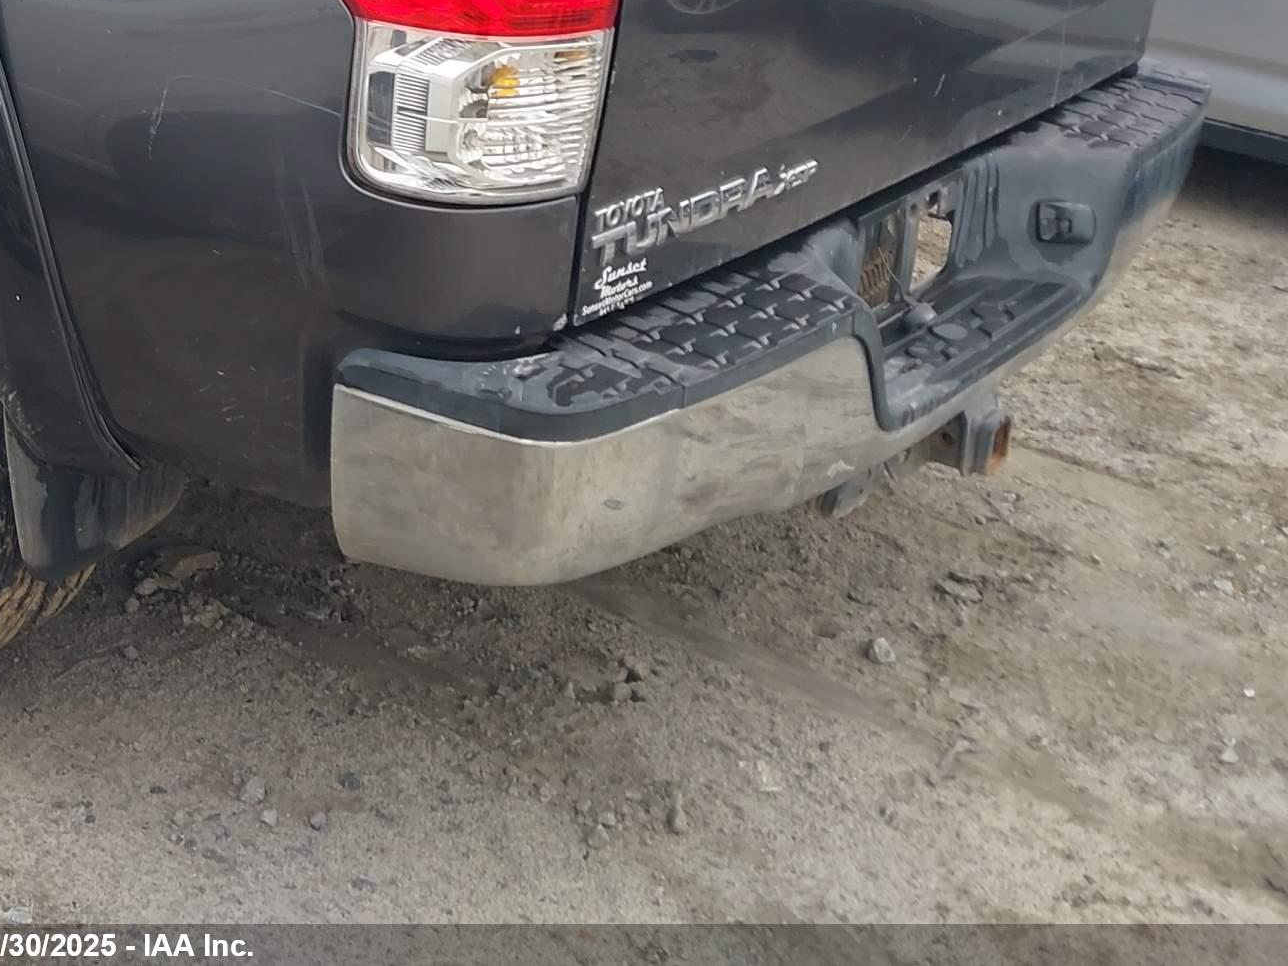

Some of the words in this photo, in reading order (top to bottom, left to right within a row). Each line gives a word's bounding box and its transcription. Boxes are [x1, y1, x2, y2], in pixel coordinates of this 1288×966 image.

[591, 167, 774, 267] TUNDRA
[595, 187, 664, 233] TOYOTA
[594, 257, 648, 290] Sunset
